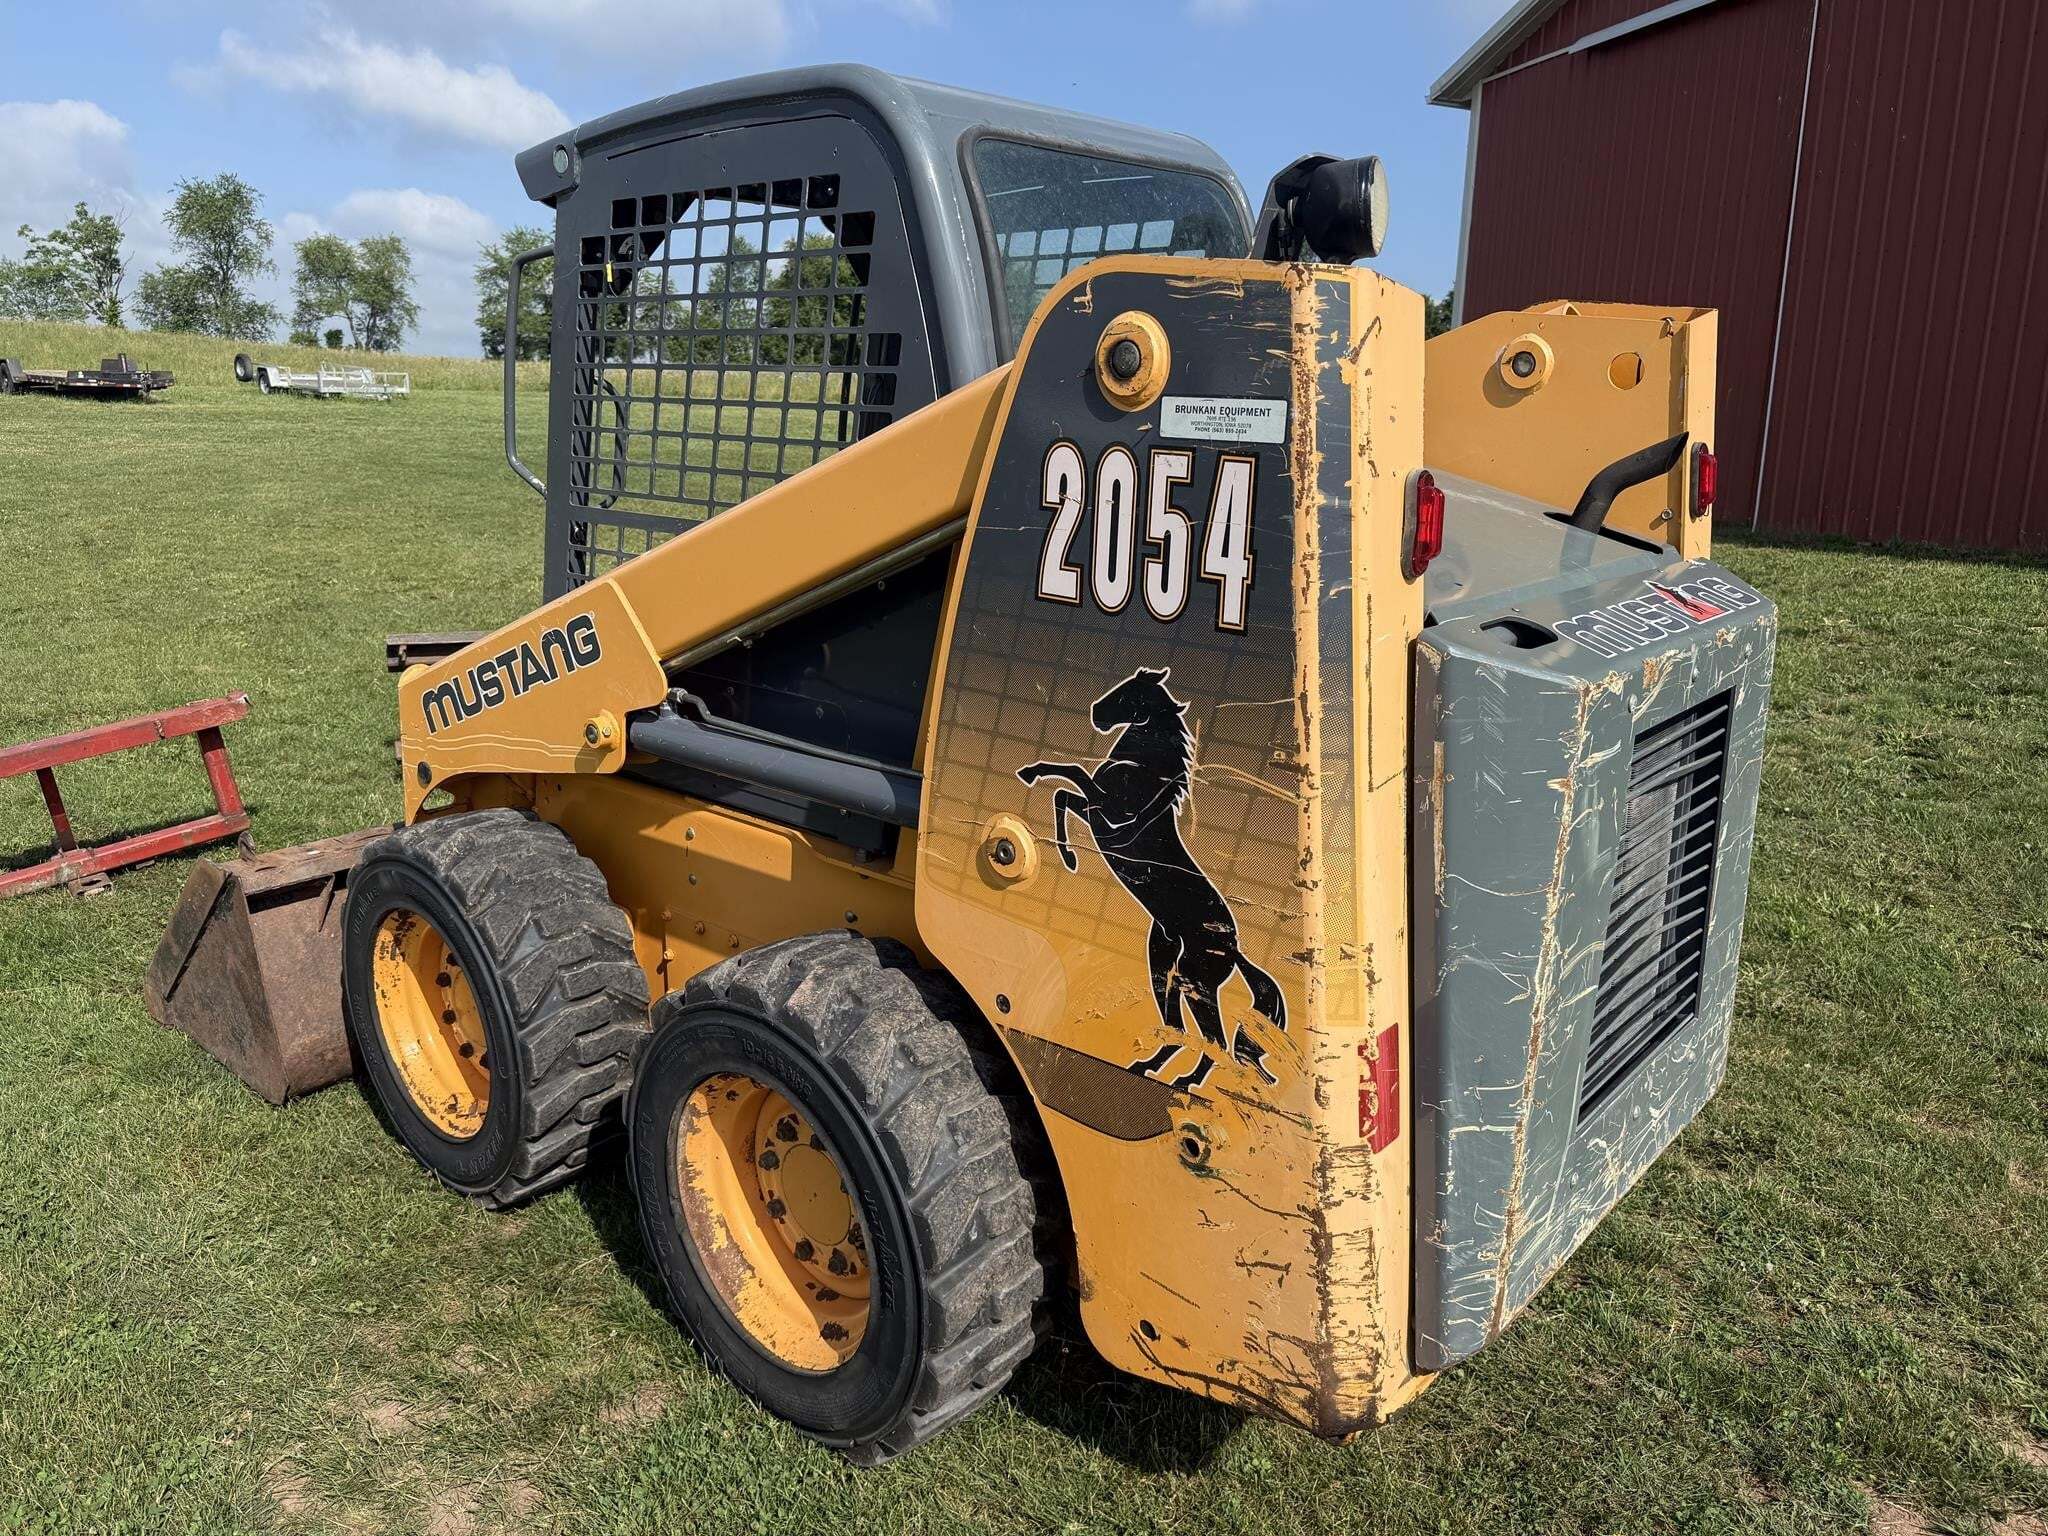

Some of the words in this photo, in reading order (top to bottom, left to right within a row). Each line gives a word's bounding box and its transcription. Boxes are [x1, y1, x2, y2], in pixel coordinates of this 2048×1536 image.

[1175, 404, 1216, 415] BRUNKAN
[1219, 406, 1272, 417] EQUIPMENT
[1036, 439, 1258, 634] 2054
[421, 612, 602, 735] MUSTANG
